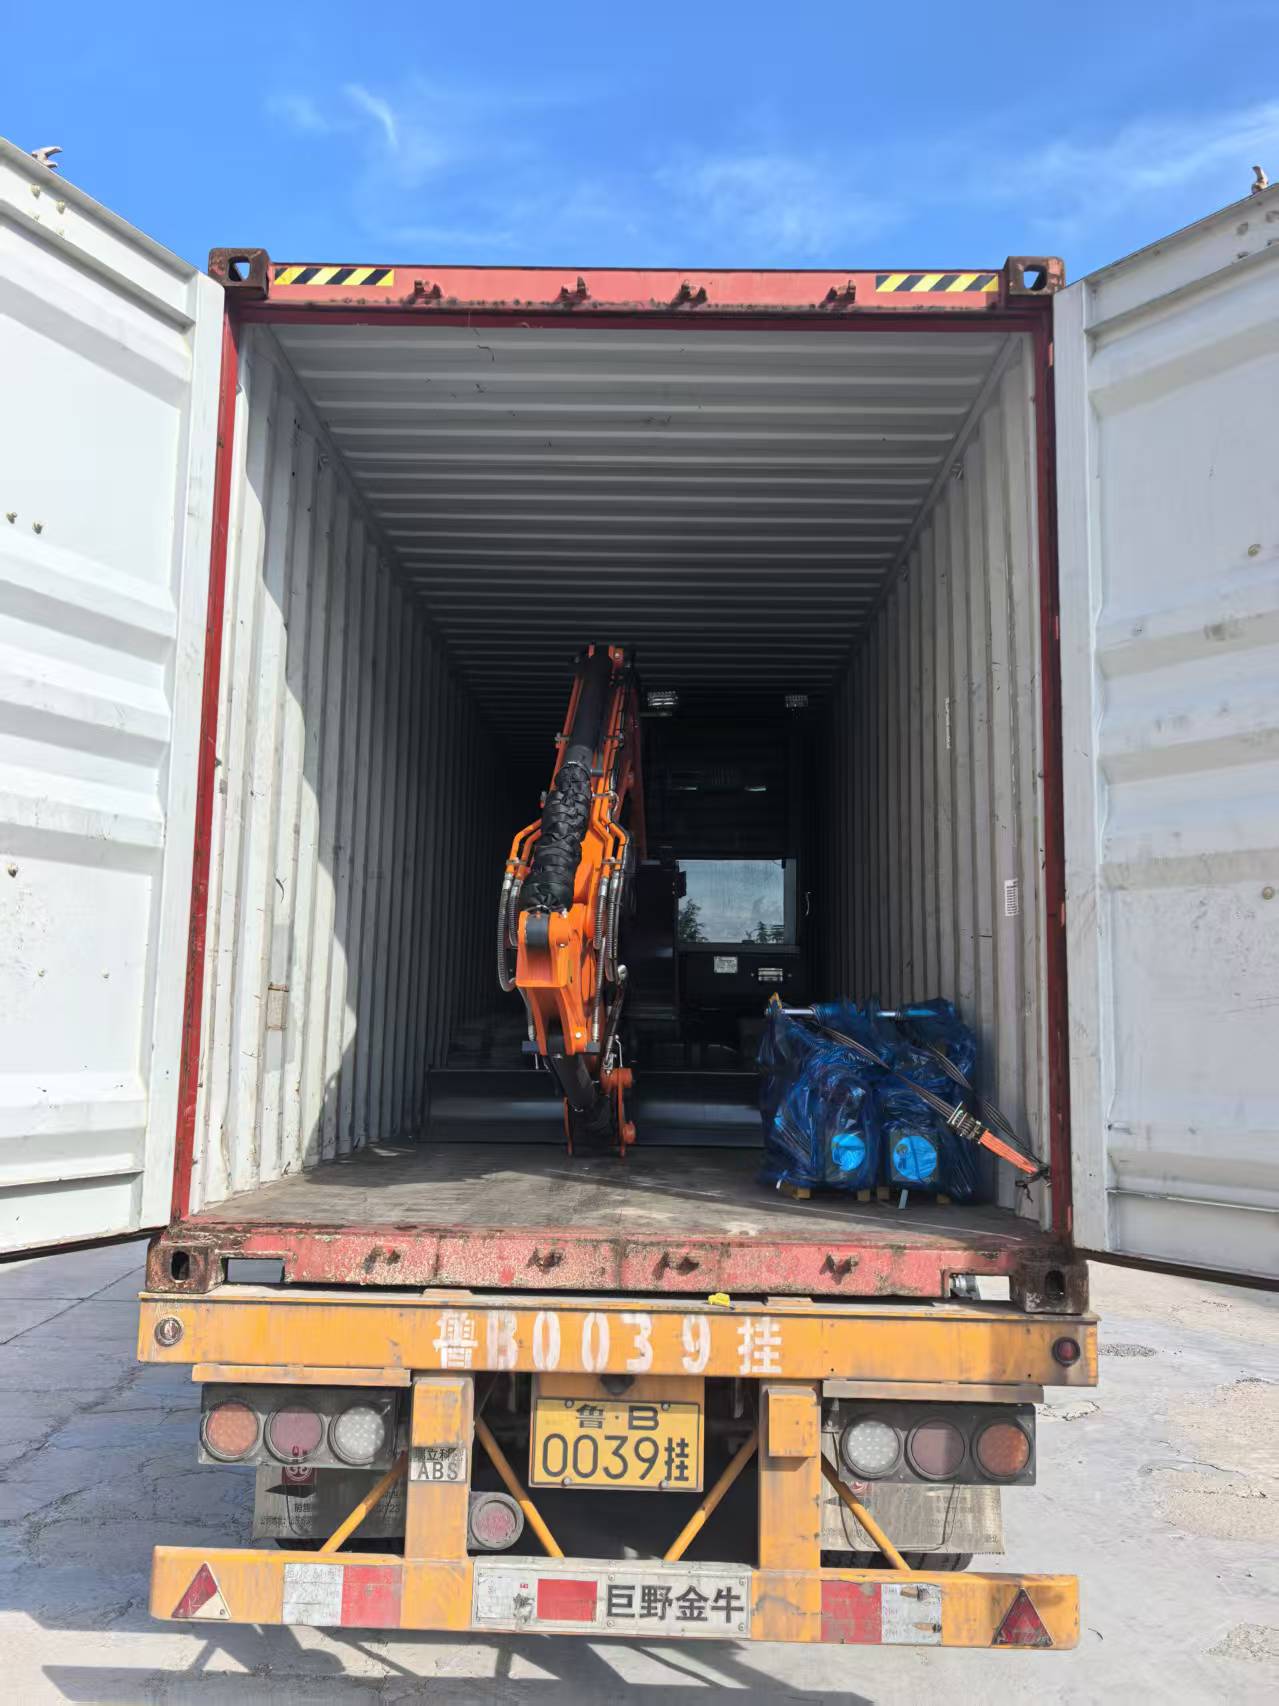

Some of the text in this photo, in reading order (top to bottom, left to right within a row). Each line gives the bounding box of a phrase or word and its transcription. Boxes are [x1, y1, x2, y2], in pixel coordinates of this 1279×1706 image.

[417, 1461, 459, 1480] ABS
[541, 1432, 690, 1482] 0039挂
[606, 1584, 745, 1623] 巨野金牛
